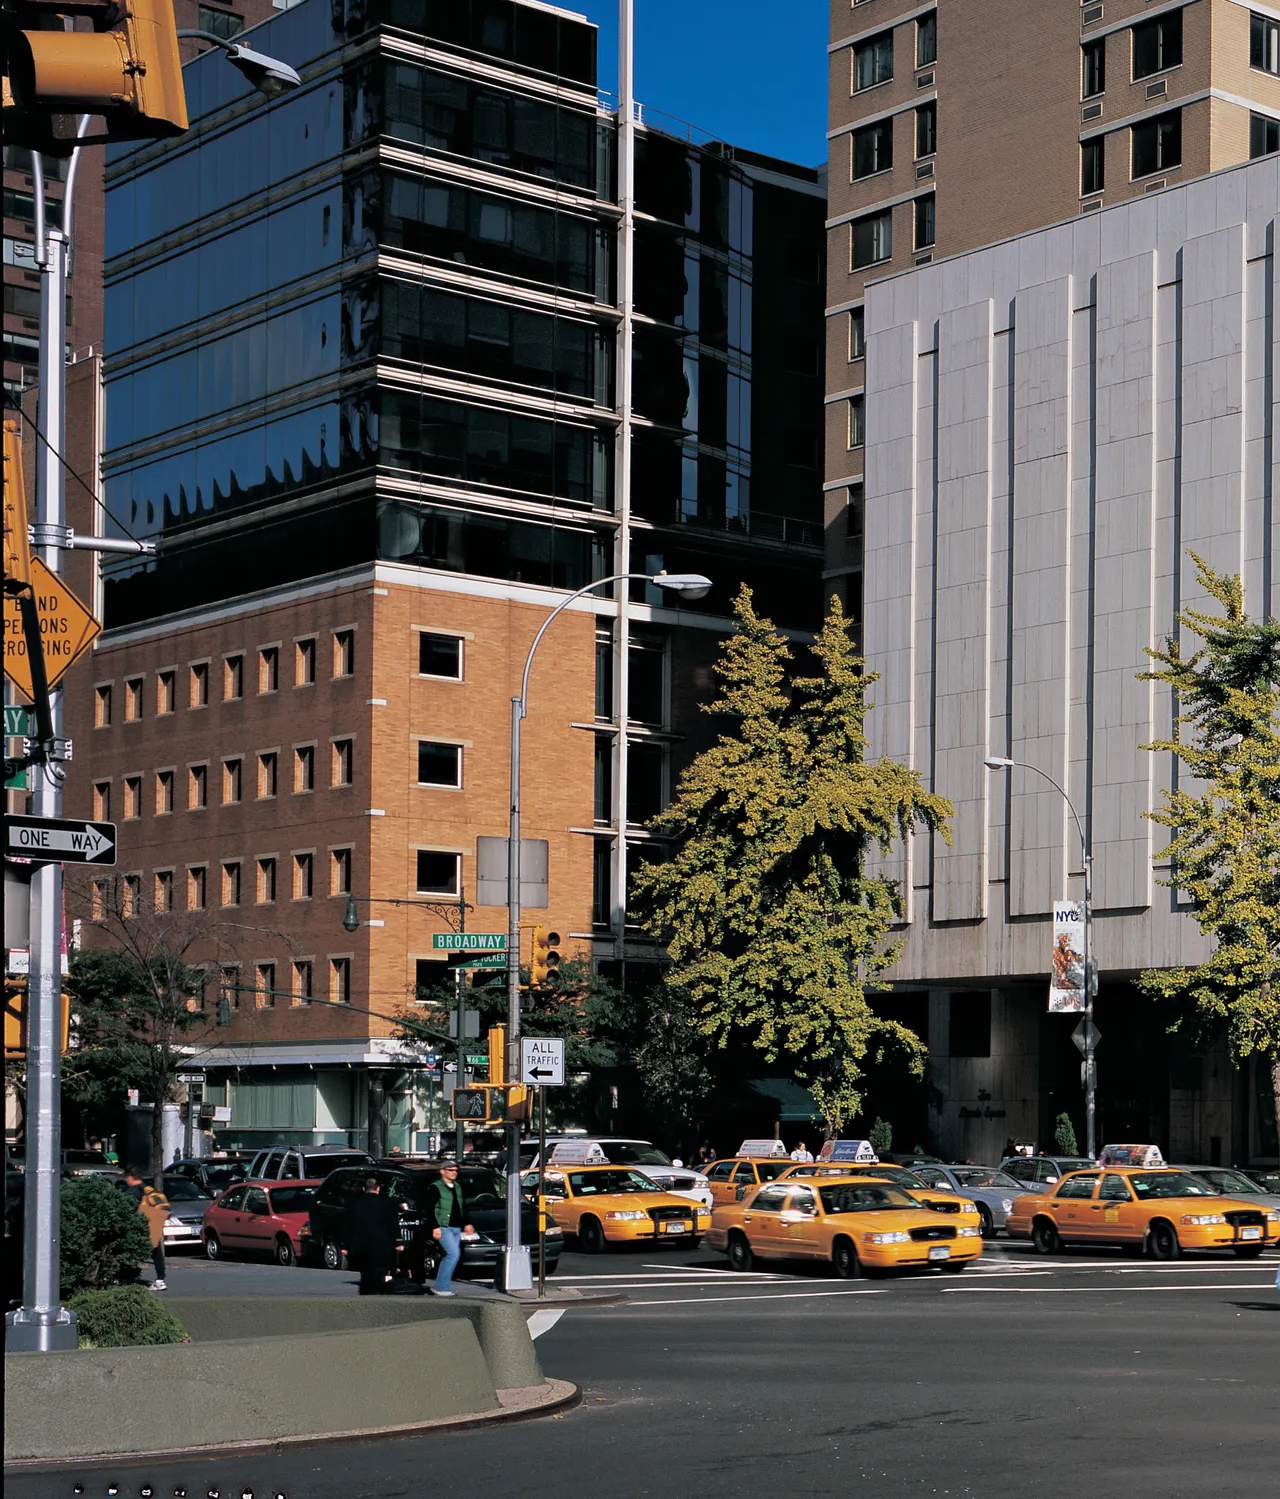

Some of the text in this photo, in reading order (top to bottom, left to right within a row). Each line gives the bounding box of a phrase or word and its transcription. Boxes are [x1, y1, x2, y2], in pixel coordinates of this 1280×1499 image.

[15, 596, 58, 611] BND
[4, 618, 68, 634] PEONS
[4, 640, 71, 656] ROING
[20, 829, 102, 851] ONE WAY
[437, 935, 502, 948] BROADWAY
[532, 1042, 554, 1053] ALL
[527, 1055, 559, 1066] TRAFFIC
